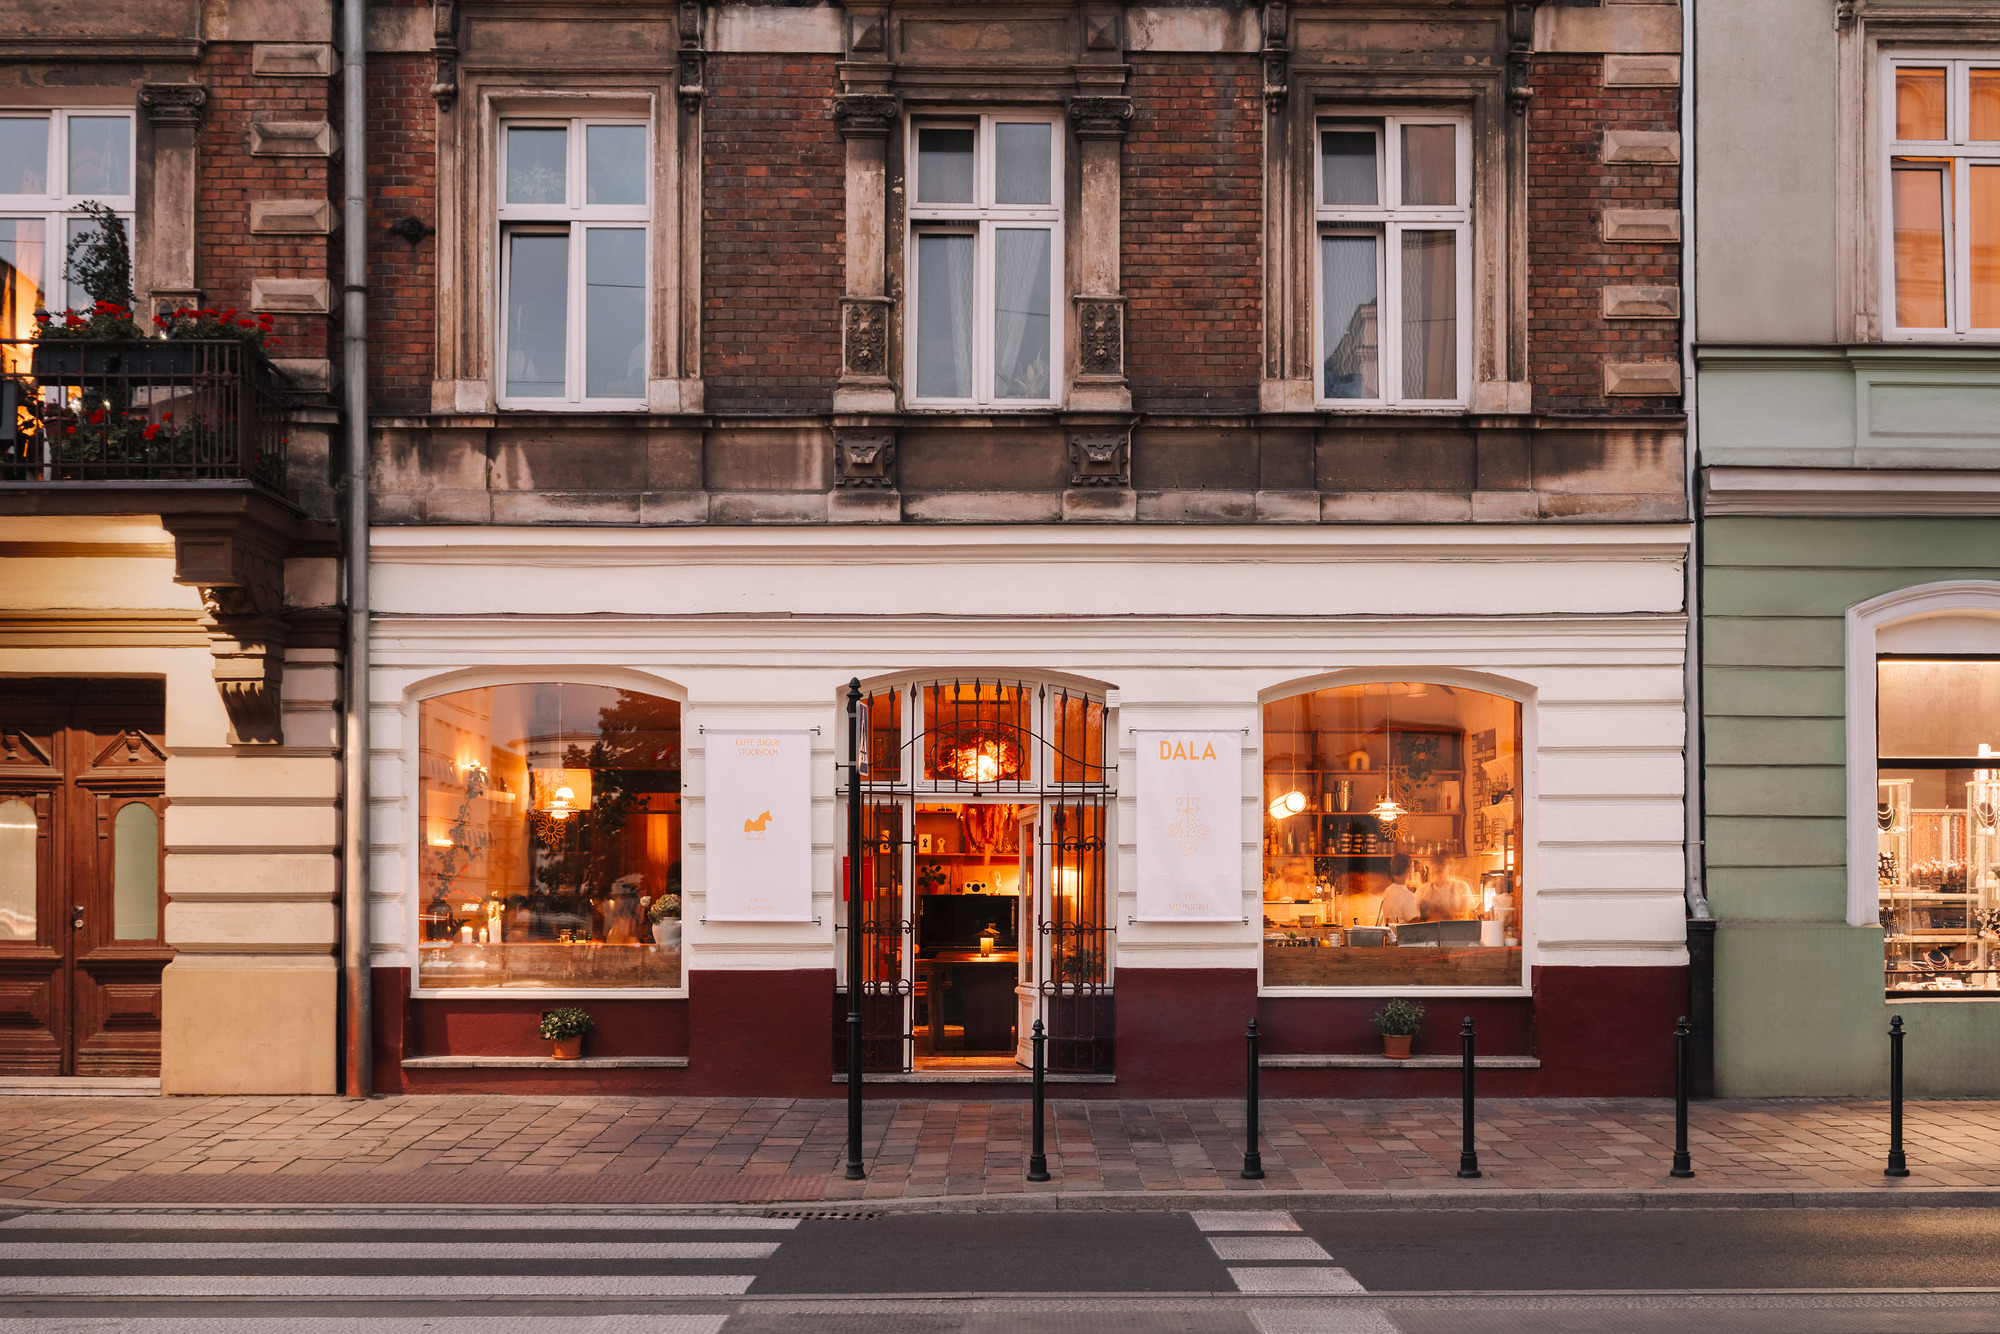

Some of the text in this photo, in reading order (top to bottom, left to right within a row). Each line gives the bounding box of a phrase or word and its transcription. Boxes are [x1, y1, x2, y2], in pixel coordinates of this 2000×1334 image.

[735, 738, 780, 746] KAFFE BAGERI
[738, 748, 778, 756] STOCKHOLM
[1160, 740, 1216, 760] DALA
